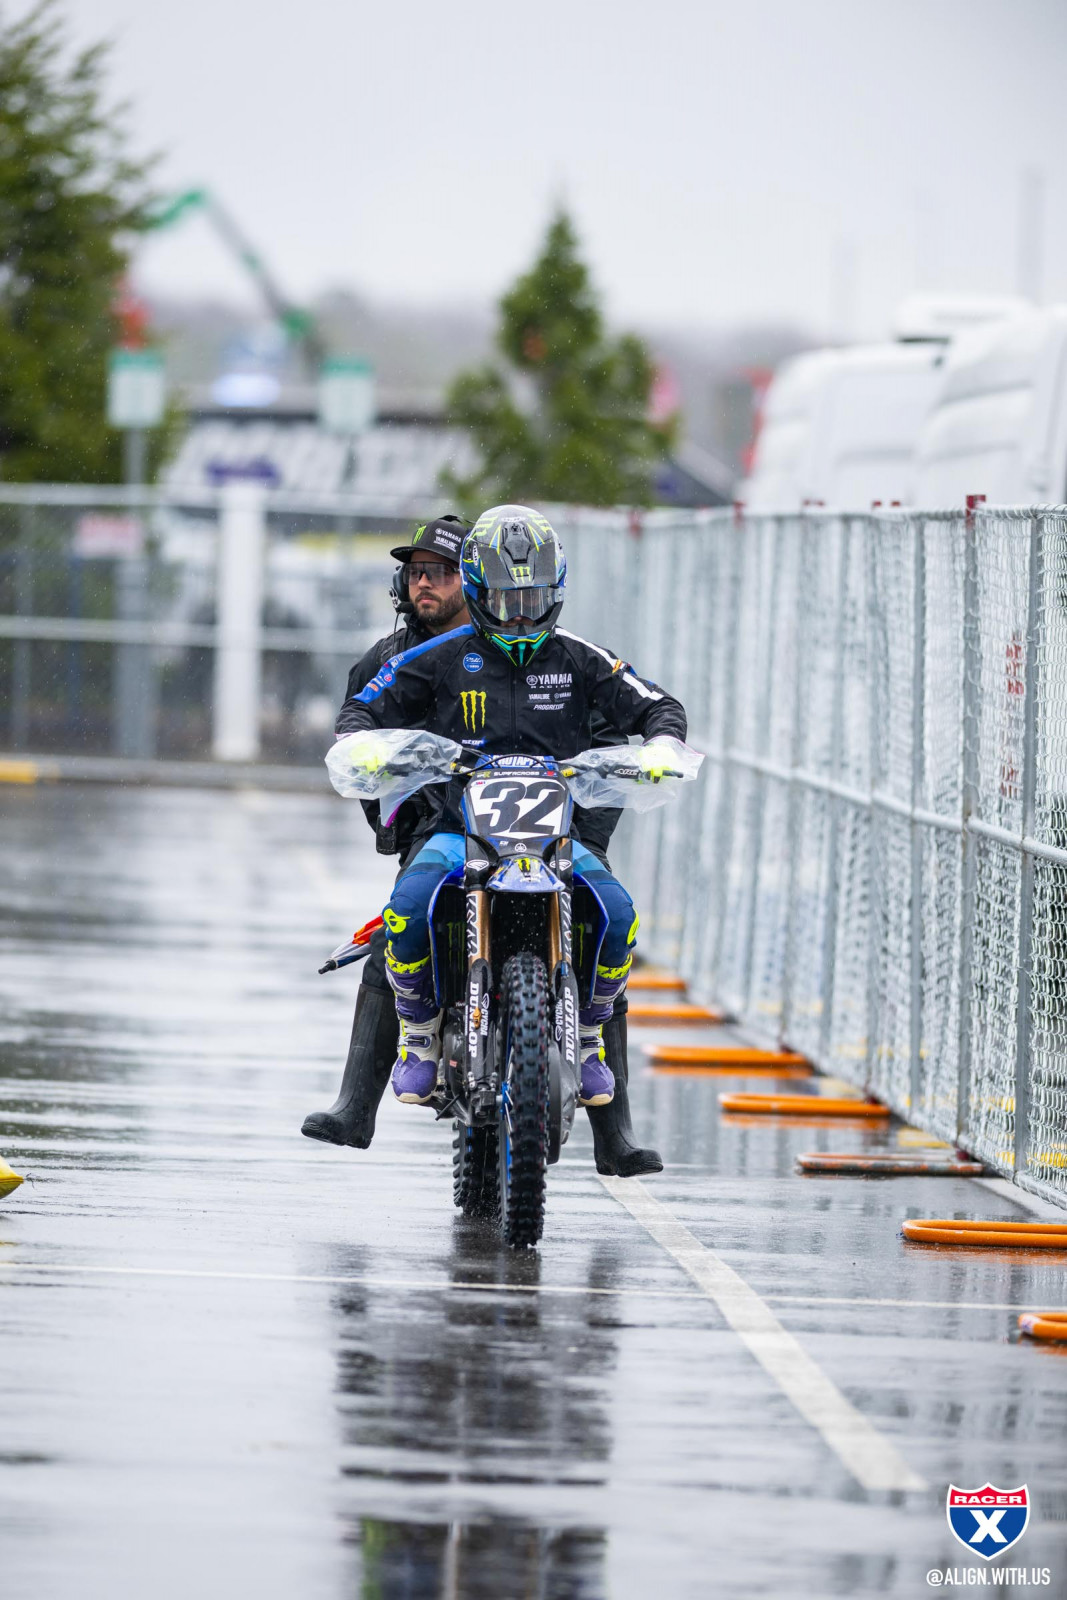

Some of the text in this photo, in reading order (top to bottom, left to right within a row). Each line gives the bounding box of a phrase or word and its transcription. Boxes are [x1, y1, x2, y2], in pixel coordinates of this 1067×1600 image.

[442, 529, 462, 543] YAMAHA
[538, 673, 573, 685] YAMAHA
[474, 781, 565, 834] 32
[481, 1009, 489, 1036] CYCRA
[564, 986, 575, 1065] DUNLOP
